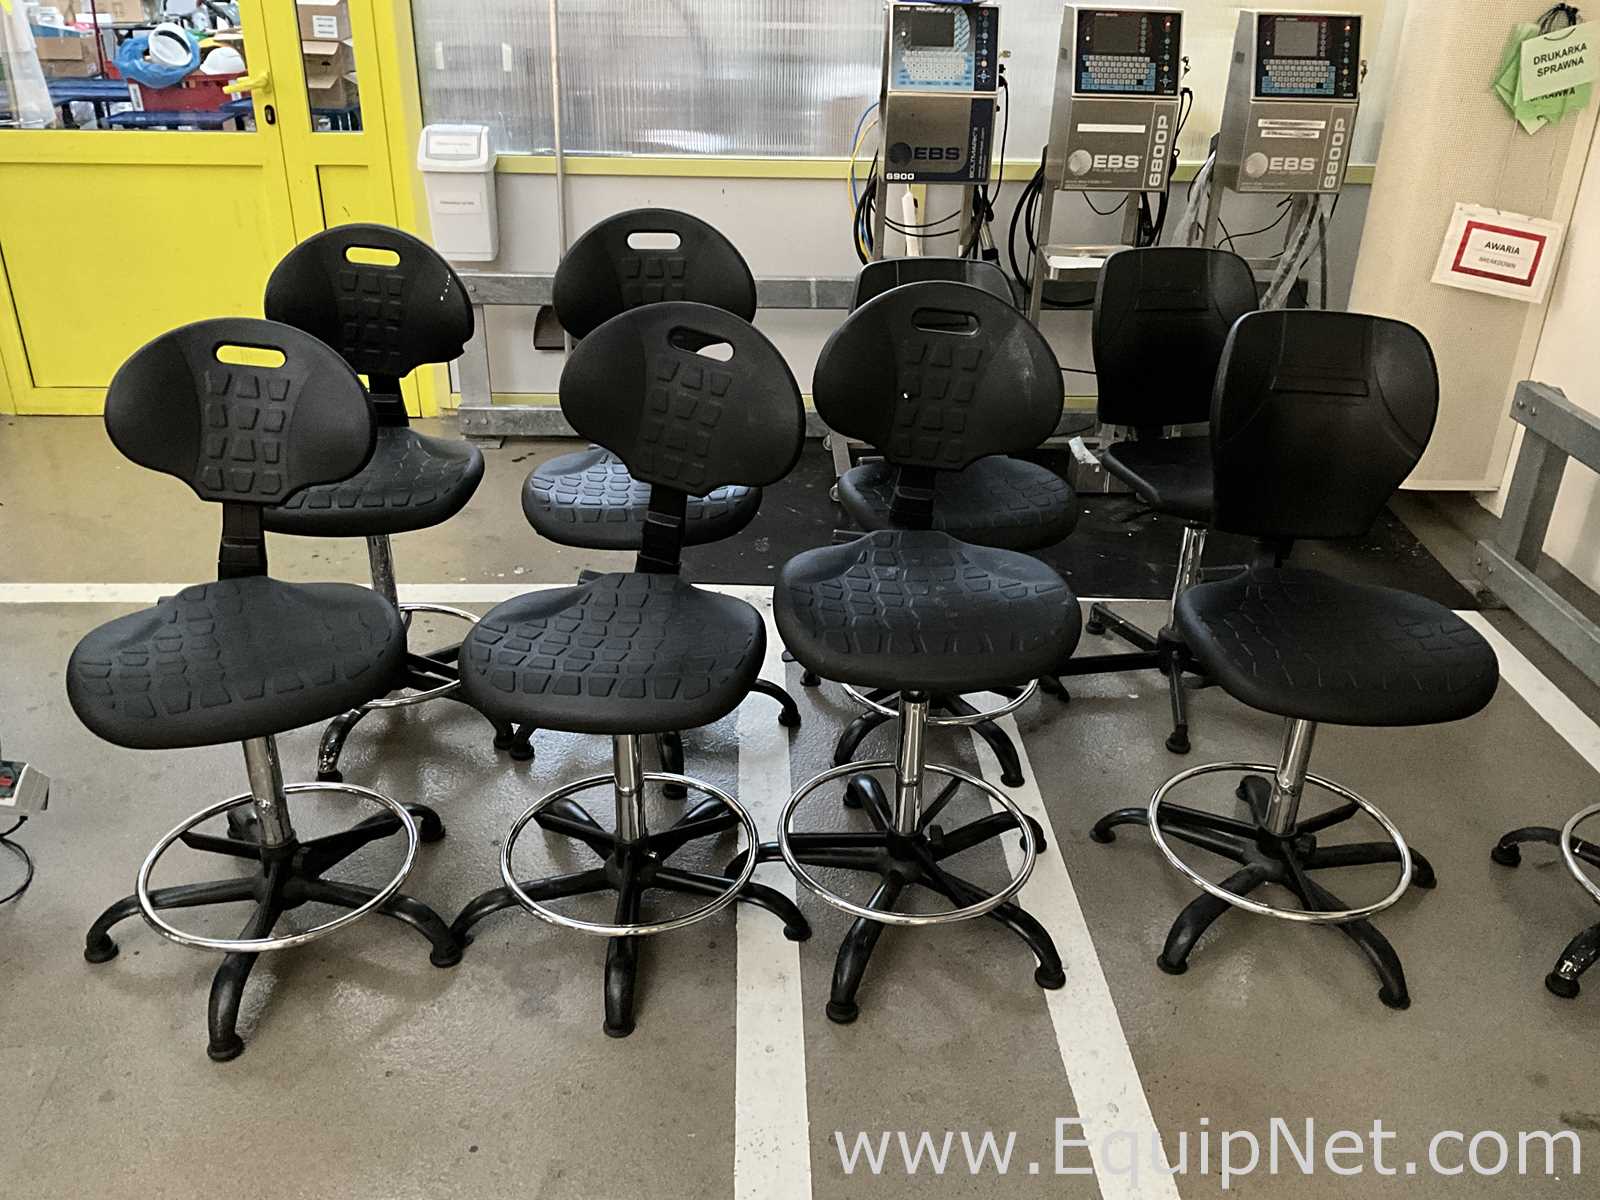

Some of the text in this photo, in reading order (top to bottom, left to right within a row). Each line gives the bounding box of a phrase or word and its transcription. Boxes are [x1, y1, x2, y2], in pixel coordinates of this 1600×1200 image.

[1533, 43, 1587, 65] DRUKARKA
[1537, 56, 1584, 77] SPRAWNA
[914, 147, 960, 160] EBS
[1149, 115, 1168, 186] 6800P
[1324, 118, 1346, 188] 6800P
[1093, 154, 1139, 169] EBS
[1269, 157, 1315, 171] EBS
[1484, 241, 1520, 255] AWARIA
